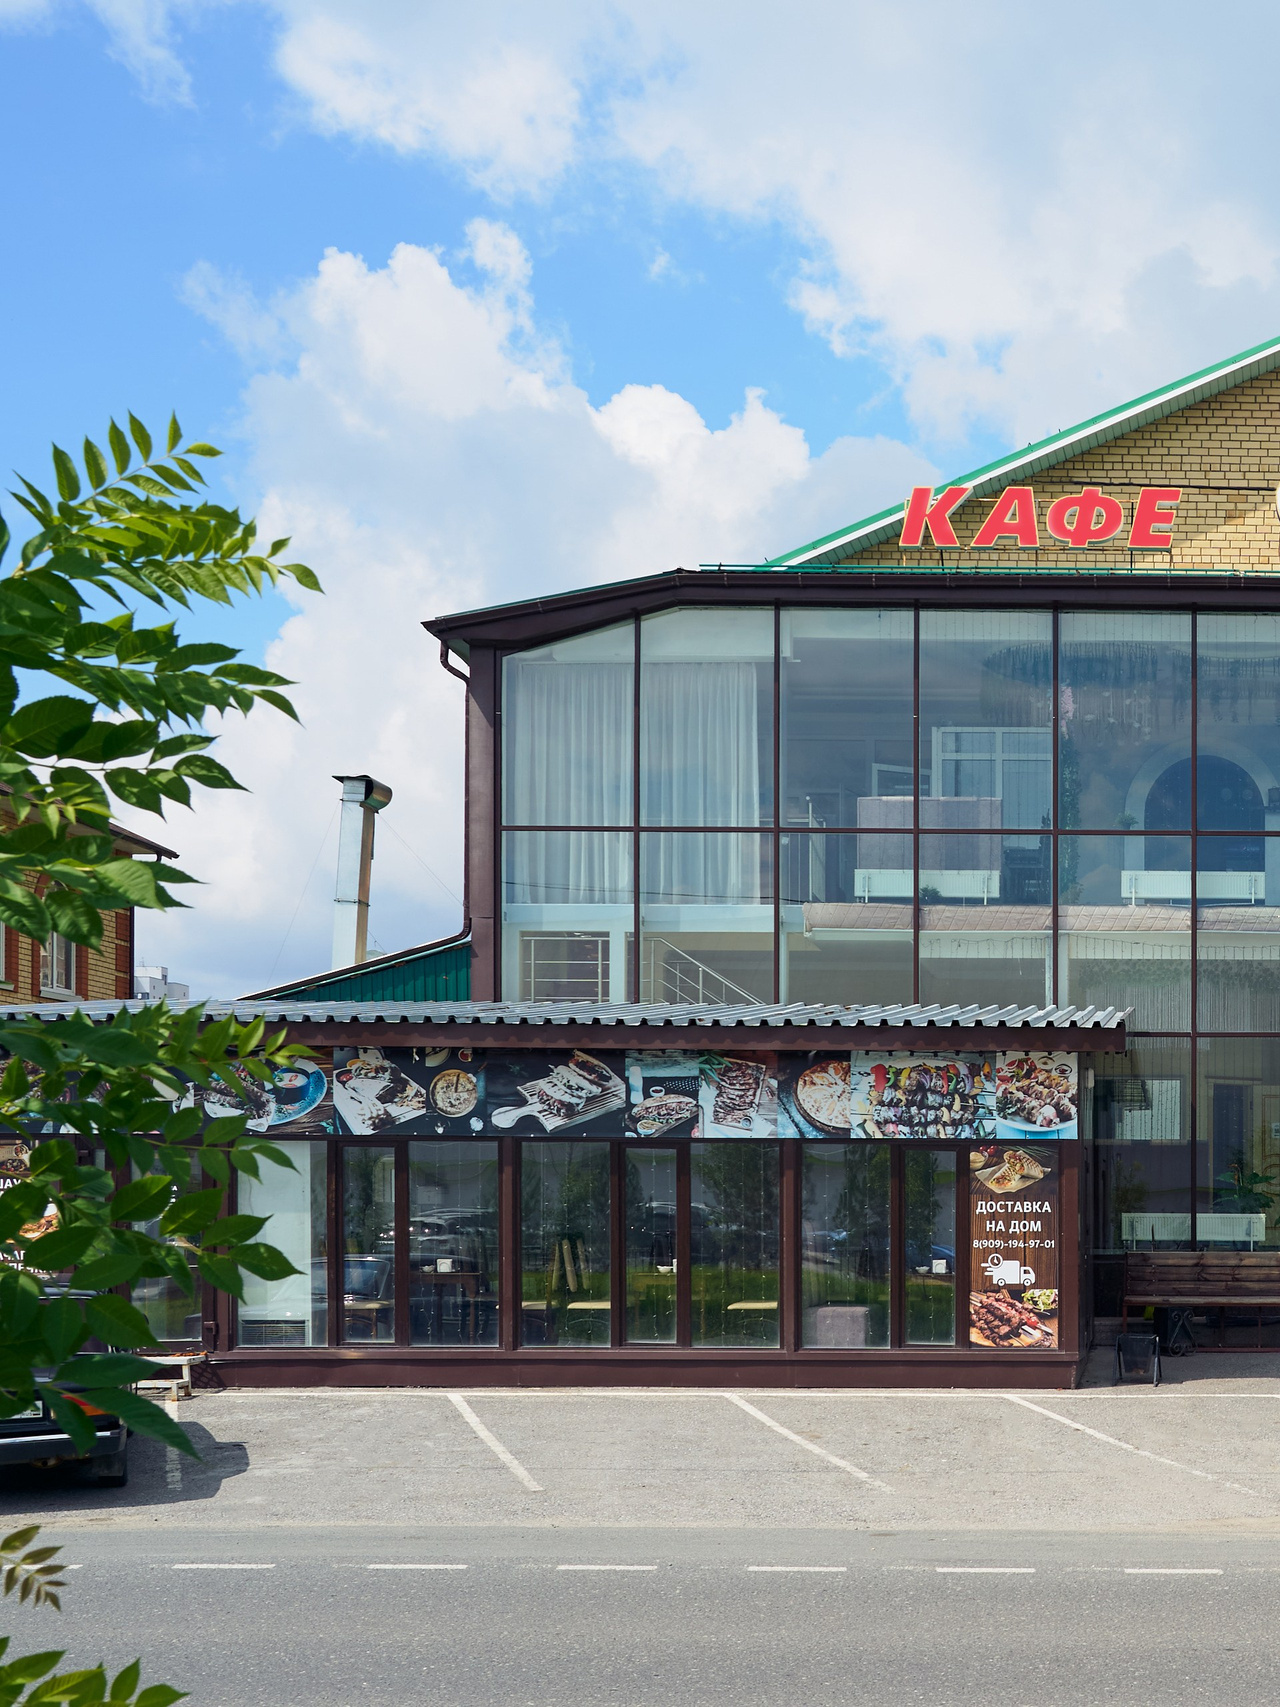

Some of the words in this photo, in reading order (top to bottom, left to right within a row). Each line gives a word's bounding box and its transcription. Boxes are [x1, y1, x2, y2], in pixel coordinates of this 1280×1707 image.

[899, 486, 1182, 550] КАФЕ
[975, 1201, 1052, 1215] ДОСТАВКА
[986, 1220, 1006, 1232] НА
[1008, 1220, 1042, 1235] ДОМ
[972, 1240, 1055, 1250] 8(909)-194-97-01
